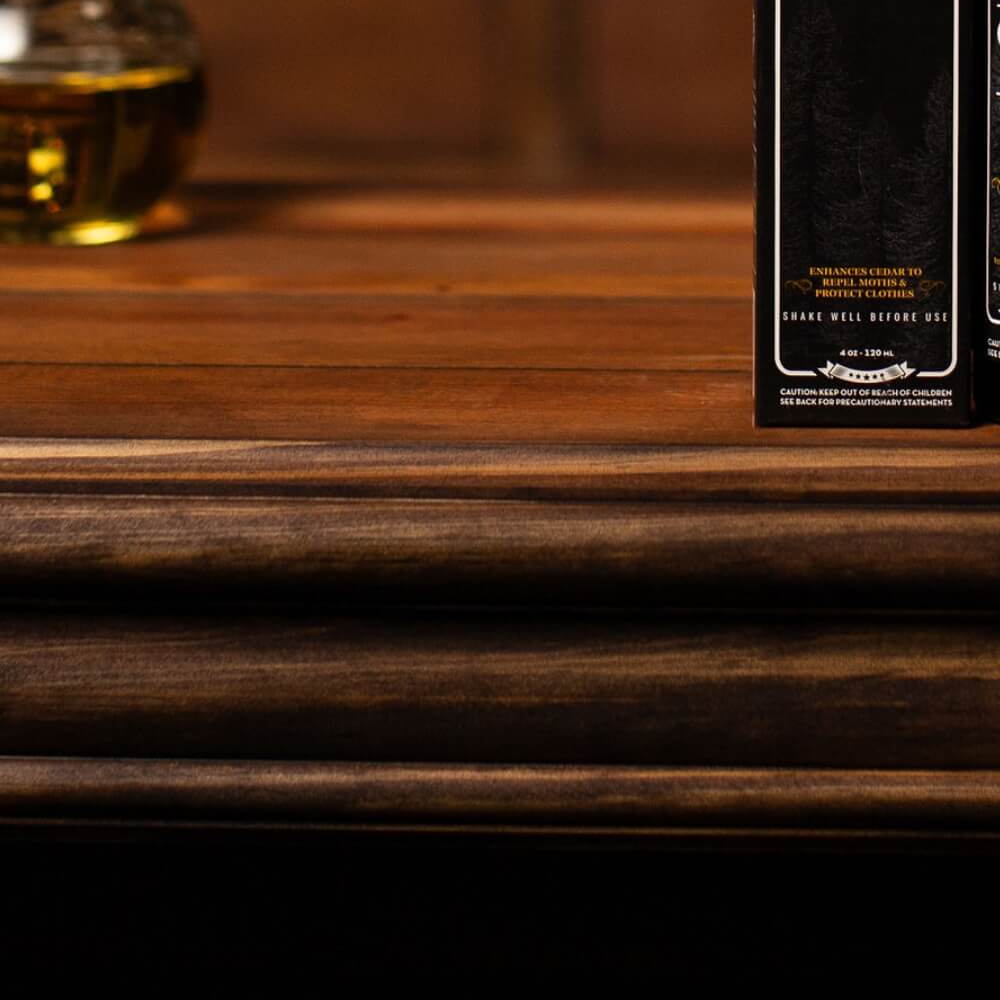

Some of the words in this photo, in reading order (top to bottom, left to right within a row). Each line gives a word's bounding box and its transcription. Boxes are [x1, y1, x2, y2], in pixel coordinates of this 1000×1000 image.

[809, 267, 867, 276] ENHANCES
[869, 267, 905, 276] CEDAR
[907, 267, 922, 276] TO
[822, 278, 857, 287] REPEL
[859, 278, 897, 287] MOTHS
[899, 278, 907, 287] &
[815, 289, 862, 298] PROTECT
[864, 289, 914, 298] CLOTHES
[782, 311, 822, 321] SHAKE
[831, 311, 861, 321] WELL
[870, 311, 917, 322] BEFORE
[925, 312, 948, 322] USE
[839, 349, 846, 357] 4
[864, 349, 882, 357] 120
[819, 388, 839, 396] KEEP
[840, 388, 857, 396] OUT
[858, 388, 870, 396] OF
[871, 388, 898, 397] REACH
[899, 388, 911, 397] OF
[912, 388, 952, 397] CHILDREN
[779, 398, 794, 406] SEE
[795, 398, 817, 406] BACK
[818, 398, 834, 406] FOR
[835, 398, 901, 407] PRECAUTIONARY
[902, 398, 952, 407] STATEMENTS
